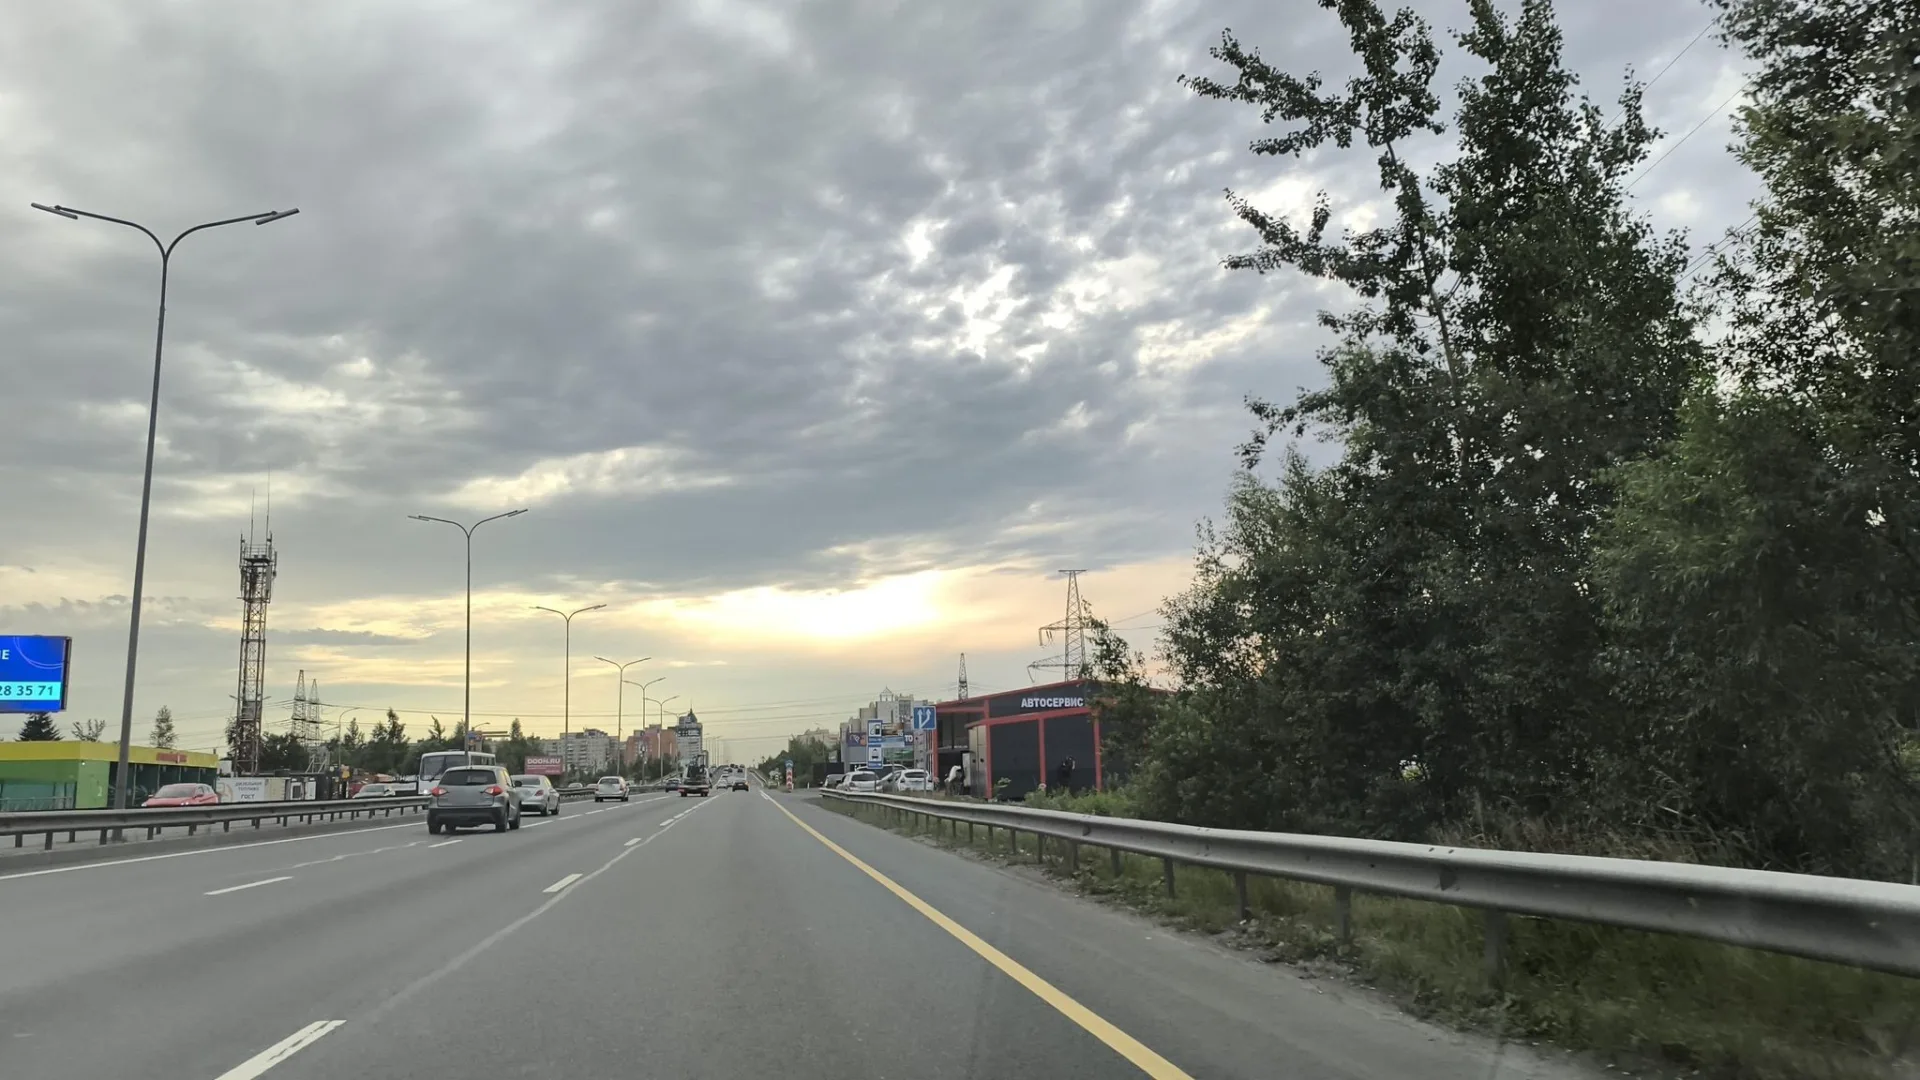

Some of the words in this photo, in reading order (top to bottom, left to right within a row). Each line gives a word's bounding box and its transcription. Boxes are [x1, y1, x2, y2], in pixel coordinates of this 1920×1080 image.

[0, 649, 10, 660] Е
[16, 685, 33, 696] 35
[38, 685, 53, 696] 71
[1021, 697, 1085, 708] АВТОСЕРВИС
